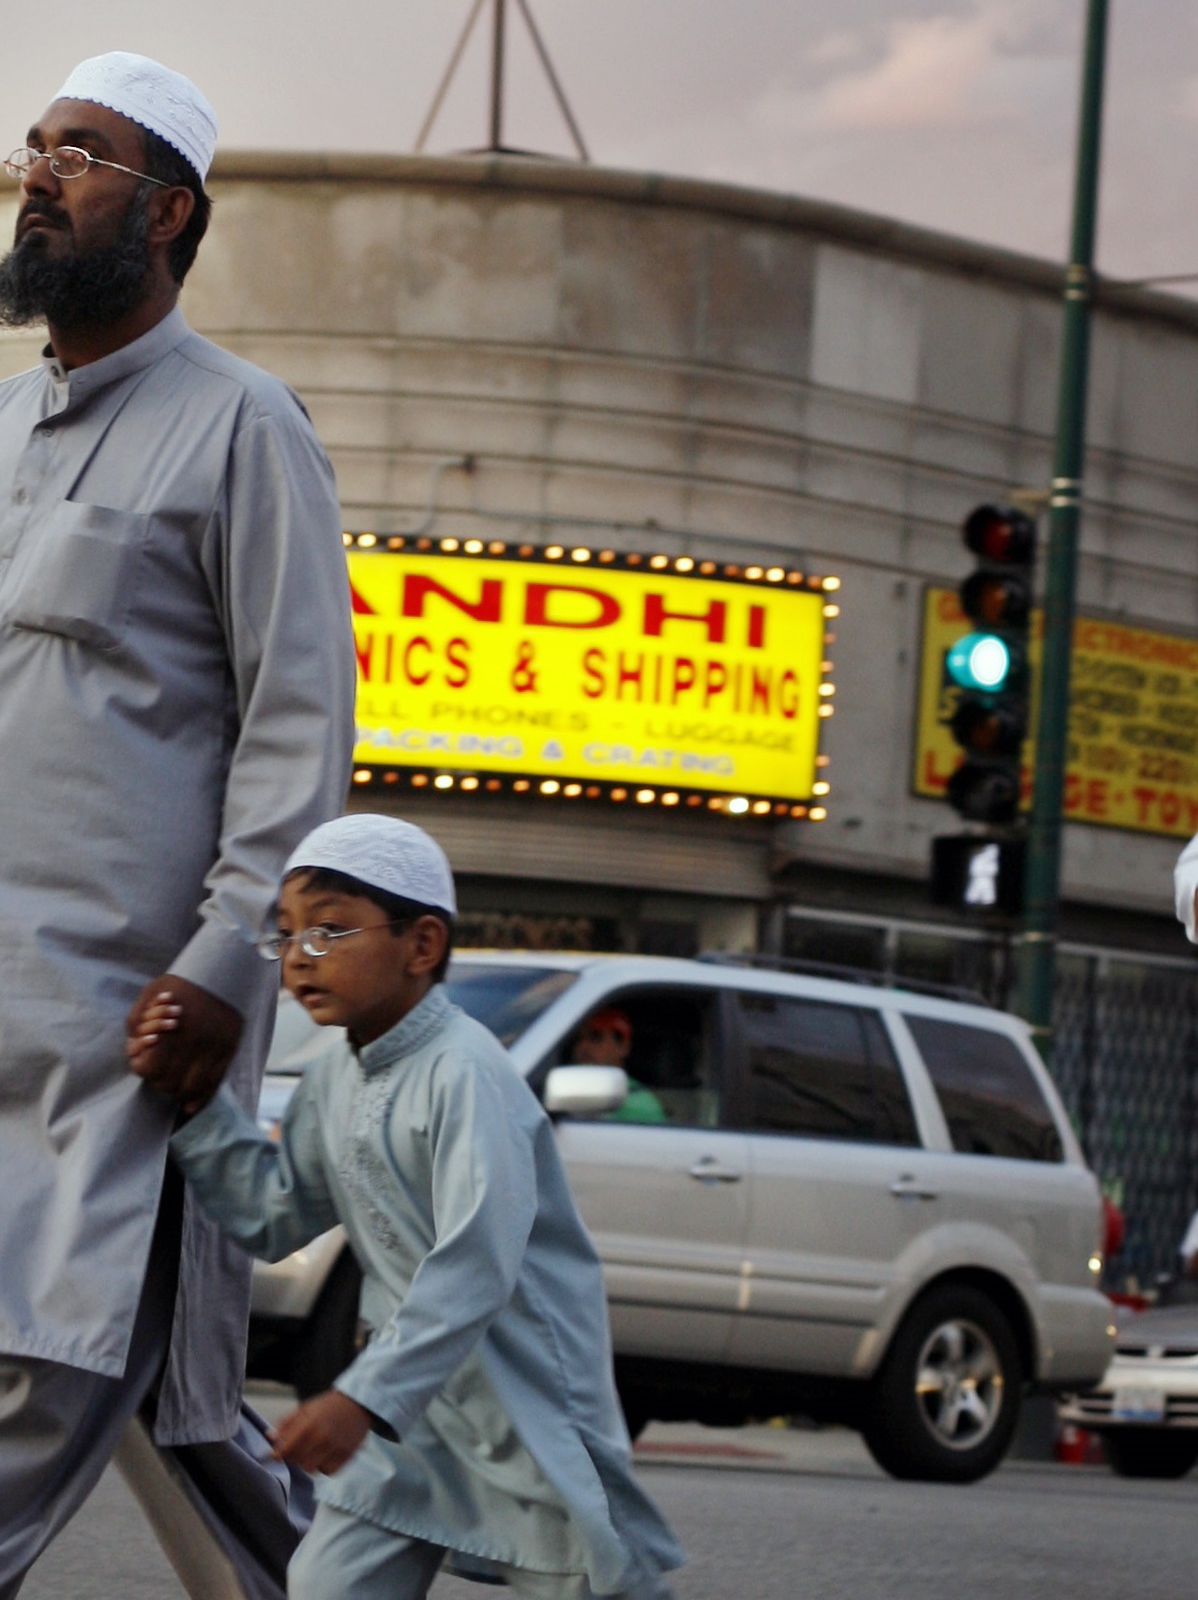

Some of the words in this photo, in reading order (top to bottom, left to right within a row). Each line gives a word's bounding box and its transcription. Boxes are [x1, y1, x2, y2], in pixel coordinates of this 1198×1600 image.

[351, 573, 767, 649] NDHI
[510, 640, 541, 694] &
[581, 647, 801, 720] SHIPPING
[431, 701, 589, 734] PHONES
[646, 717, 797, 752] LUGGAGE
[542, 741, 564, 761] &
[583, 743, 735, 778] CRATING
